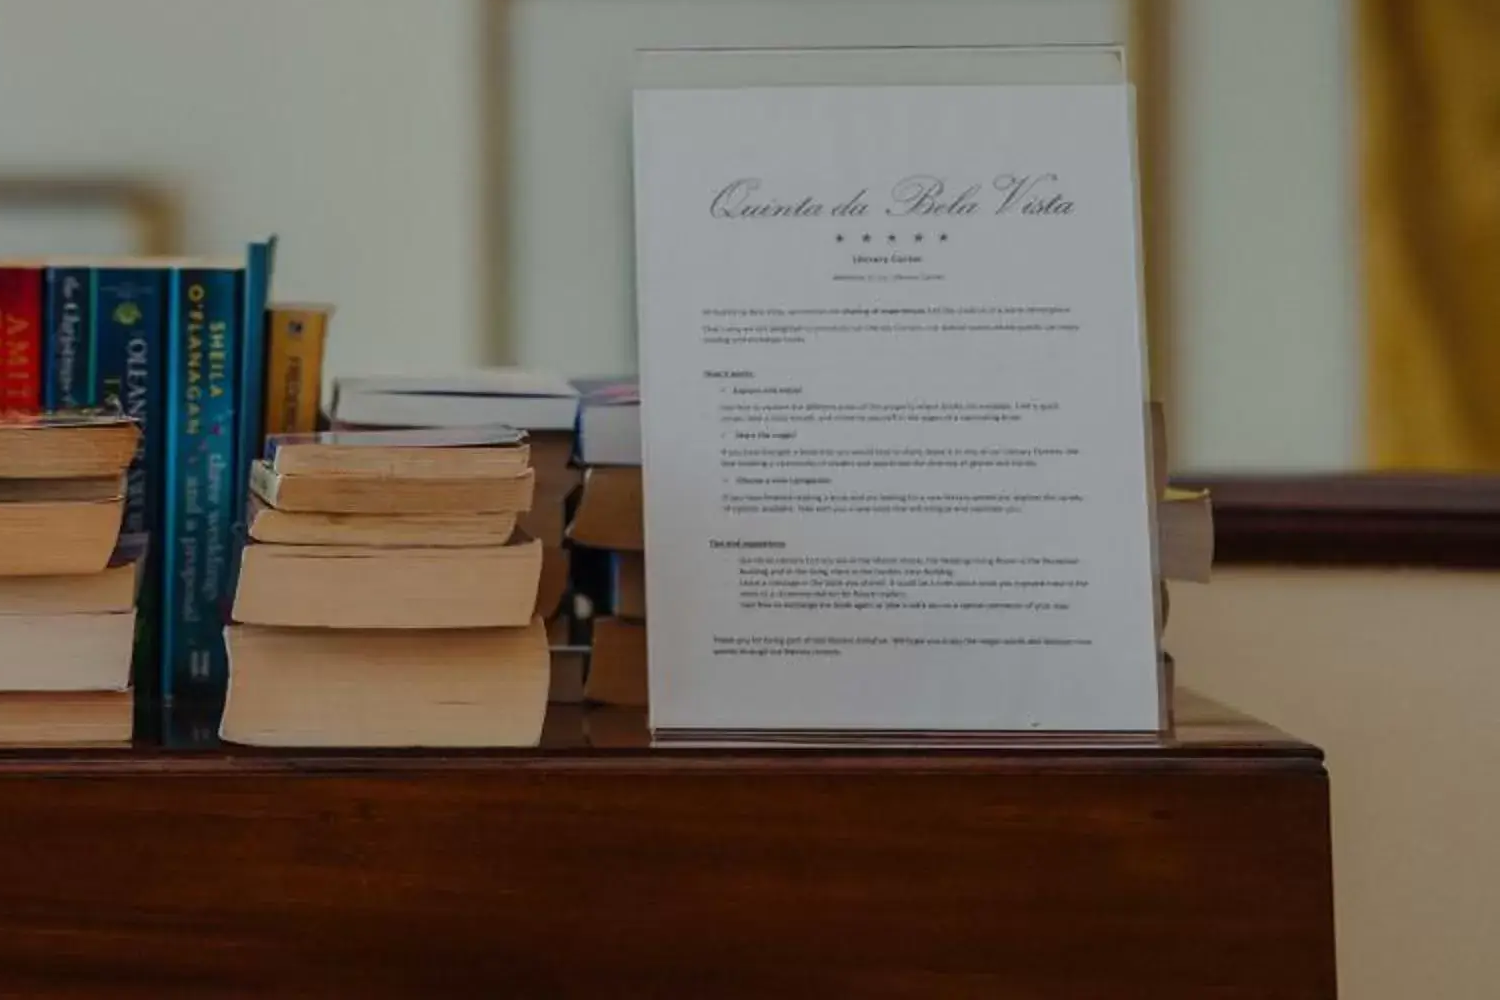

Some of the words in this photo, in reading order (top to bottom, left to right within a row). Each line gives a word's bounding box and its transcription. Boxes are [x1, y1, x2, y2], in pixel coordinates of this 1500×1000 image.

[708, 176, 823, 219] Quinta
[831, 189, 869, 218] da
[885, 174, 982, 217] Bela
[992, 173, 1076, 217] Vista
[185, 283, 206, 434] O'FLANAGAN
[208, 319, 227, 398] SHEILA
